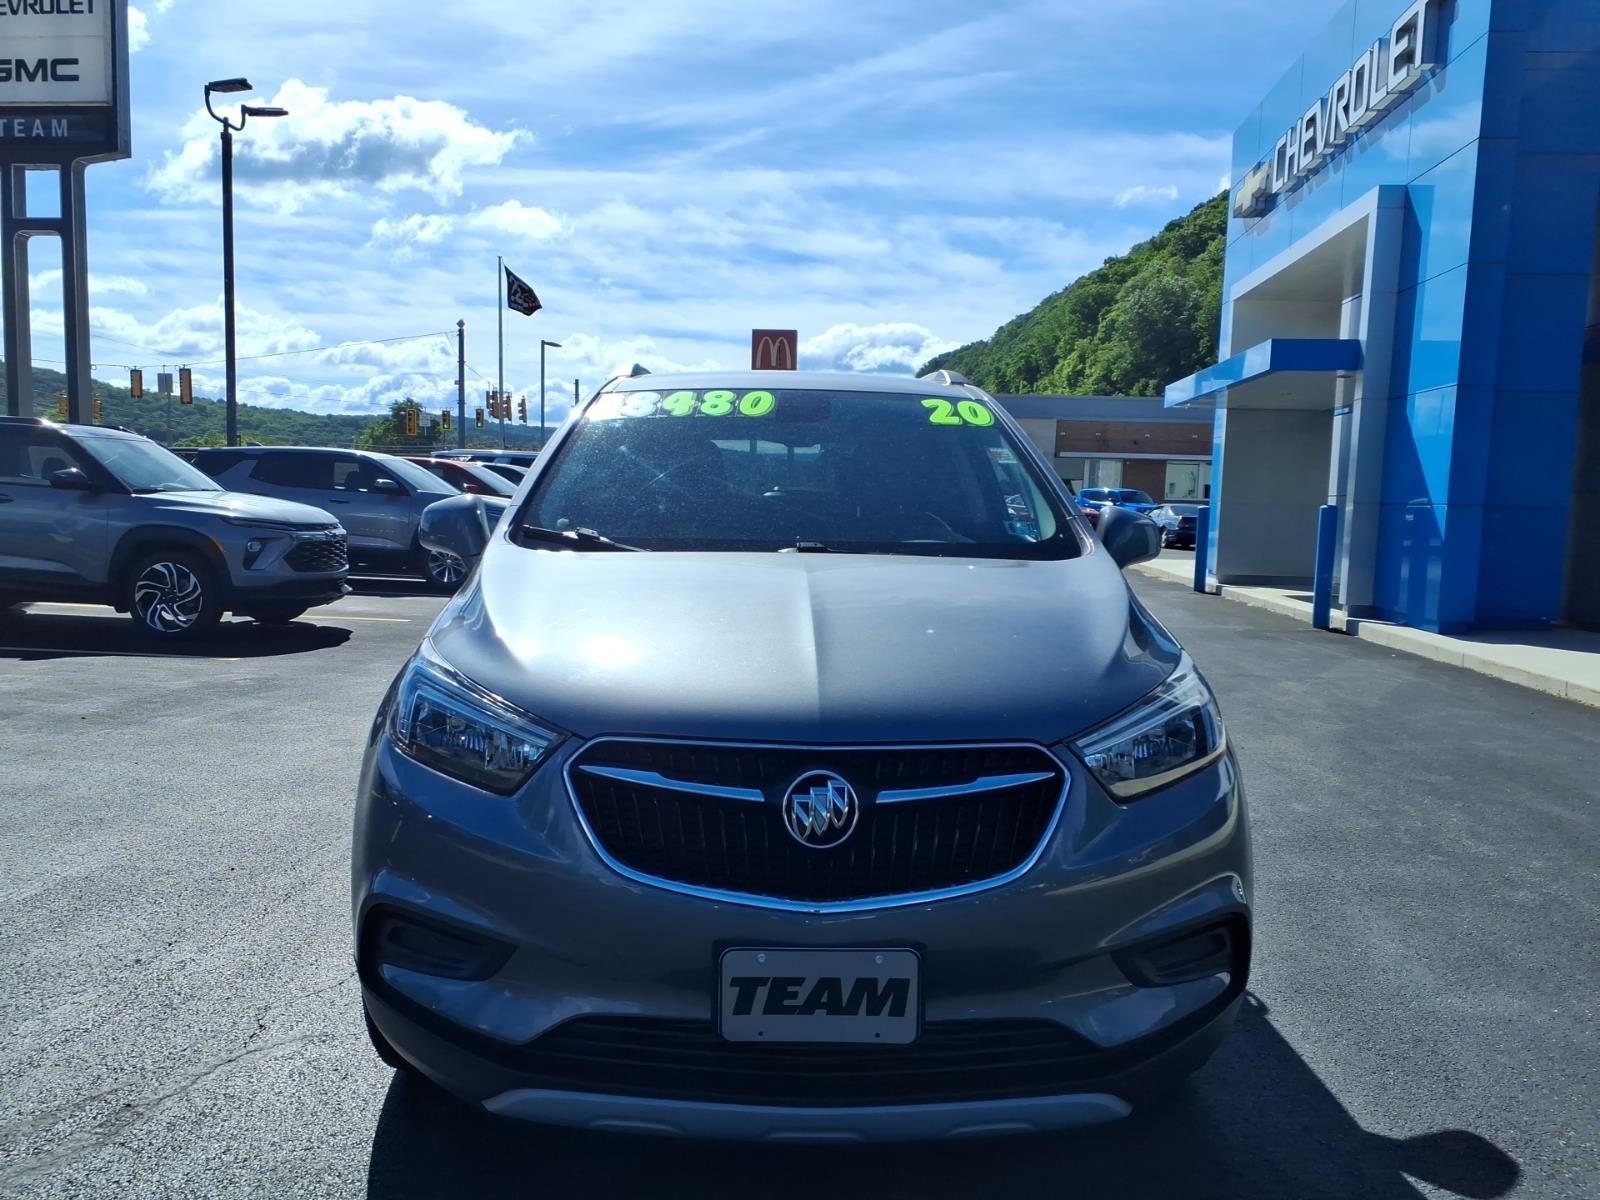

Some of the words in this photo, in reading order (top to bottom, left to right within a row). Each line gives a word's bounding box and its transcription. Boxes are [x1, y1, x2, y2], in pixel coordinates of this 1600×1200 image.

[1271, 0, 1432, 194] CHEVROLET
[0, 119, 68, 137] TEAM
[600, 389, 776, 417] 8480
[920, 399, 995, 427] 20
[729, 976, 911, 1018] TEAM
